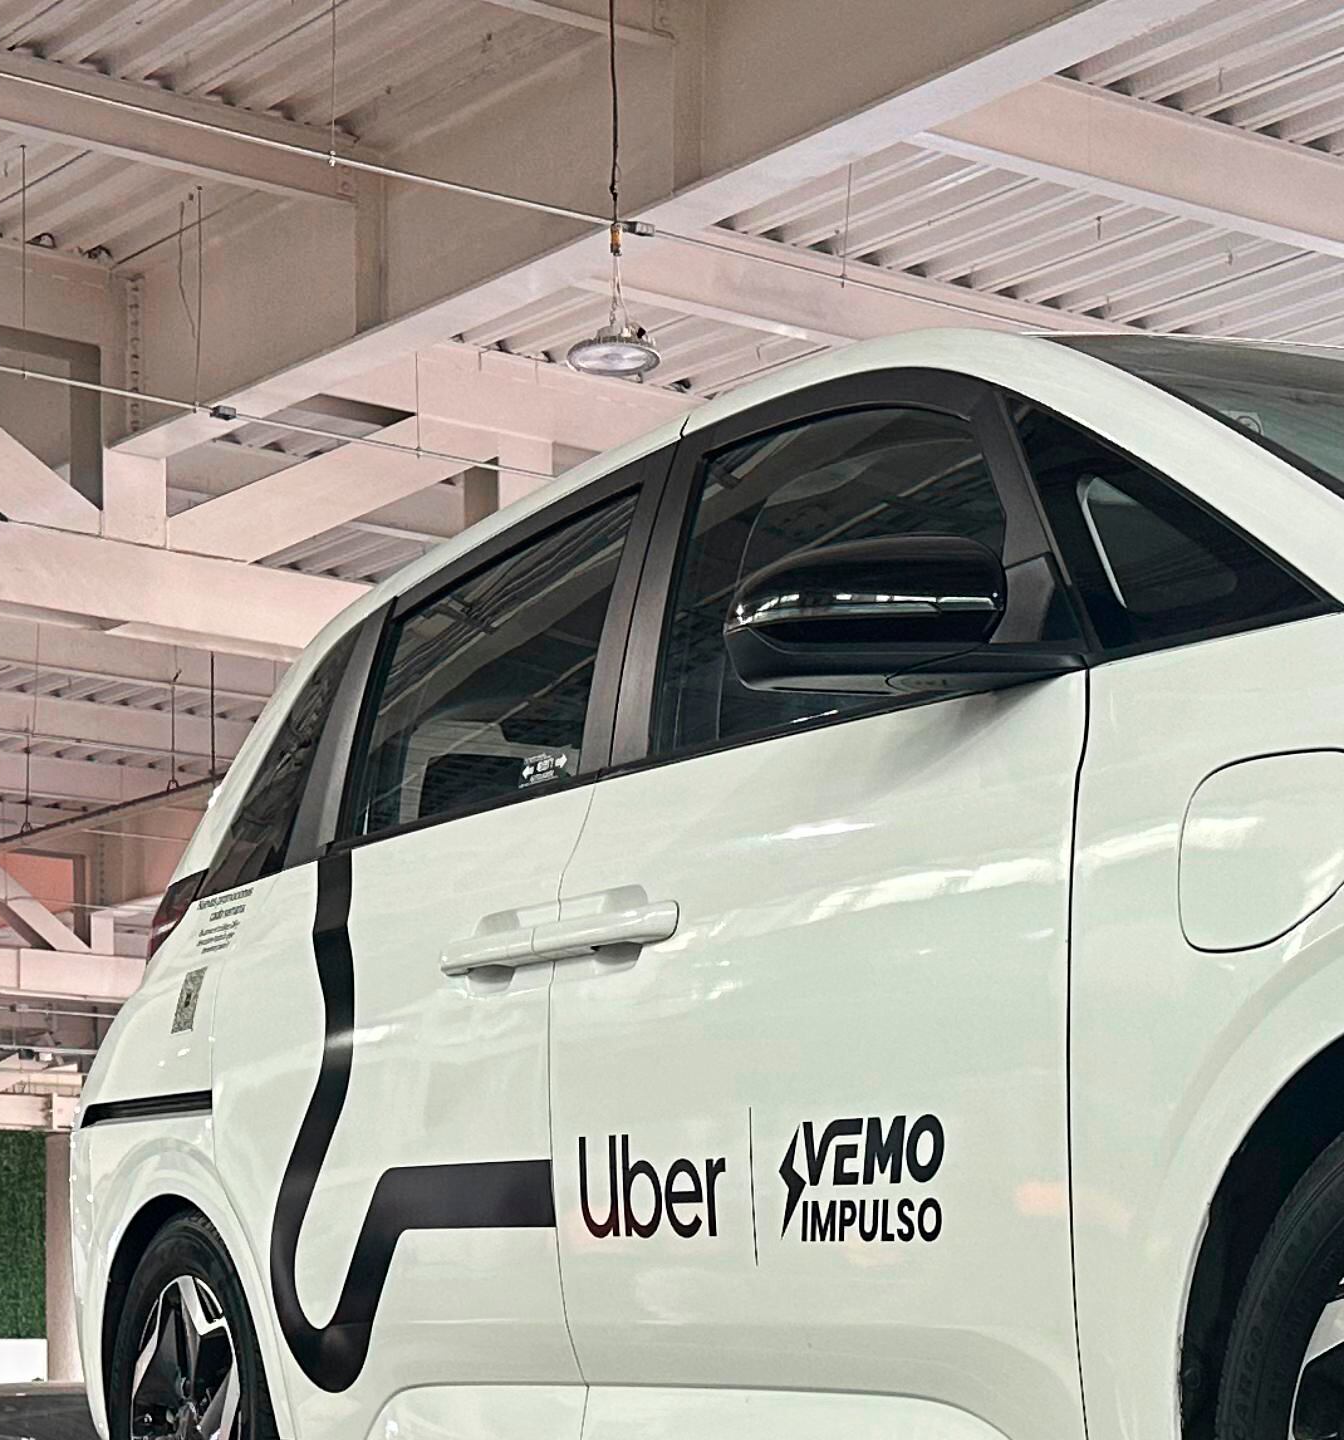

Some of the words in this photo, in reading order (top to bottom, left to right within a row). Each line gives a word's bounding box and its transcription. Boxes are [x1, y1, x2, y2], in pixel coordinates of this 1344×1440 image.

[578, 1133, 727, 1239] Uber
[802, 1113, 945, 1187] VEMO
[800, 1197, 944, 1243] IMPULSO
